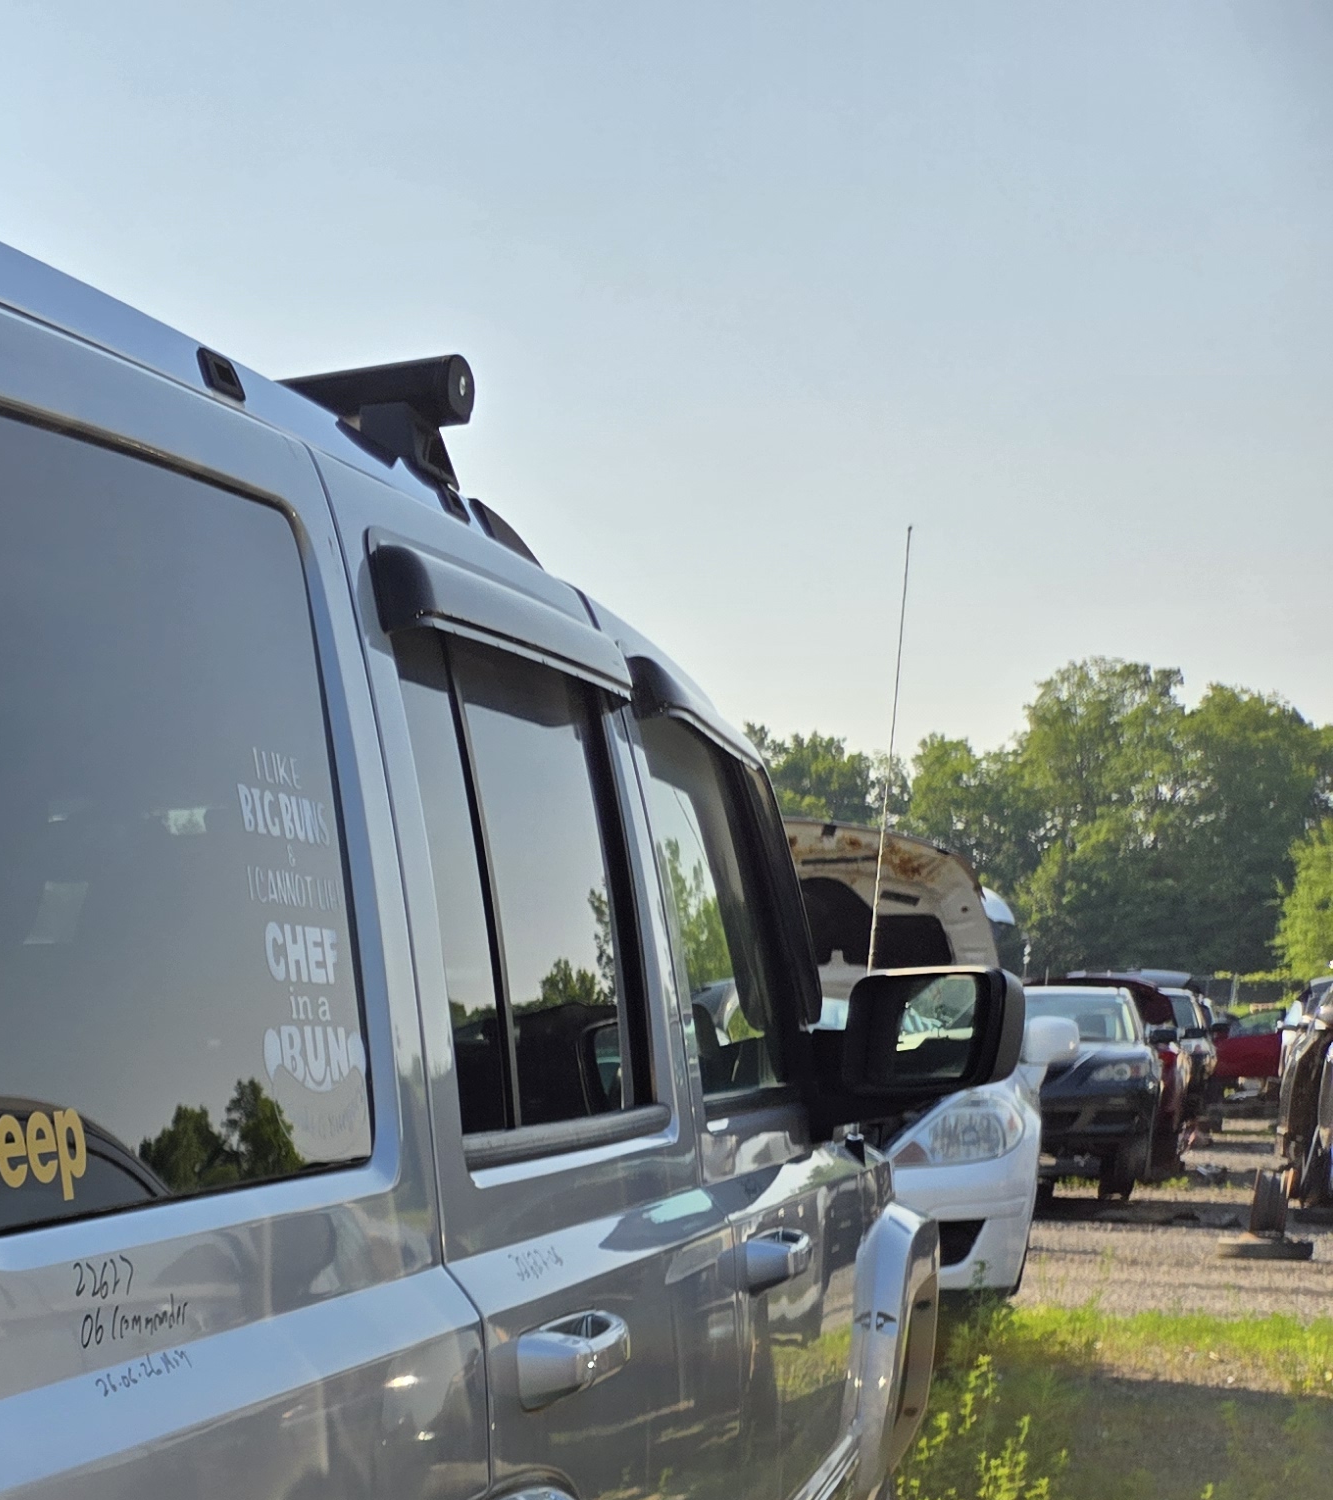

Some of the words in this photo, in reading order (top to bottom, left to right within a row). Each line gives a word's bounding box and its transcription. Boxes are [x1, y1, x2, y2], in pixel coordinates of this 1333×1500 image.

[252, 746, 262, 780] I
[261, 750, 303, 790] LIKE
[236, 782, 282, 838] BIG
[277, 792, 331, 846] BUNS
[246, 864, 255, 901] I
[254, 865, 315, 908] CANNOT
[264, 921, 338, 985] CHEF
[288, 986, 313, 1021] in
[317, 995, 332, 1022] a
[279, 1024, 349, 1088] BUN
[80, 1306, 105, 1349] 06
